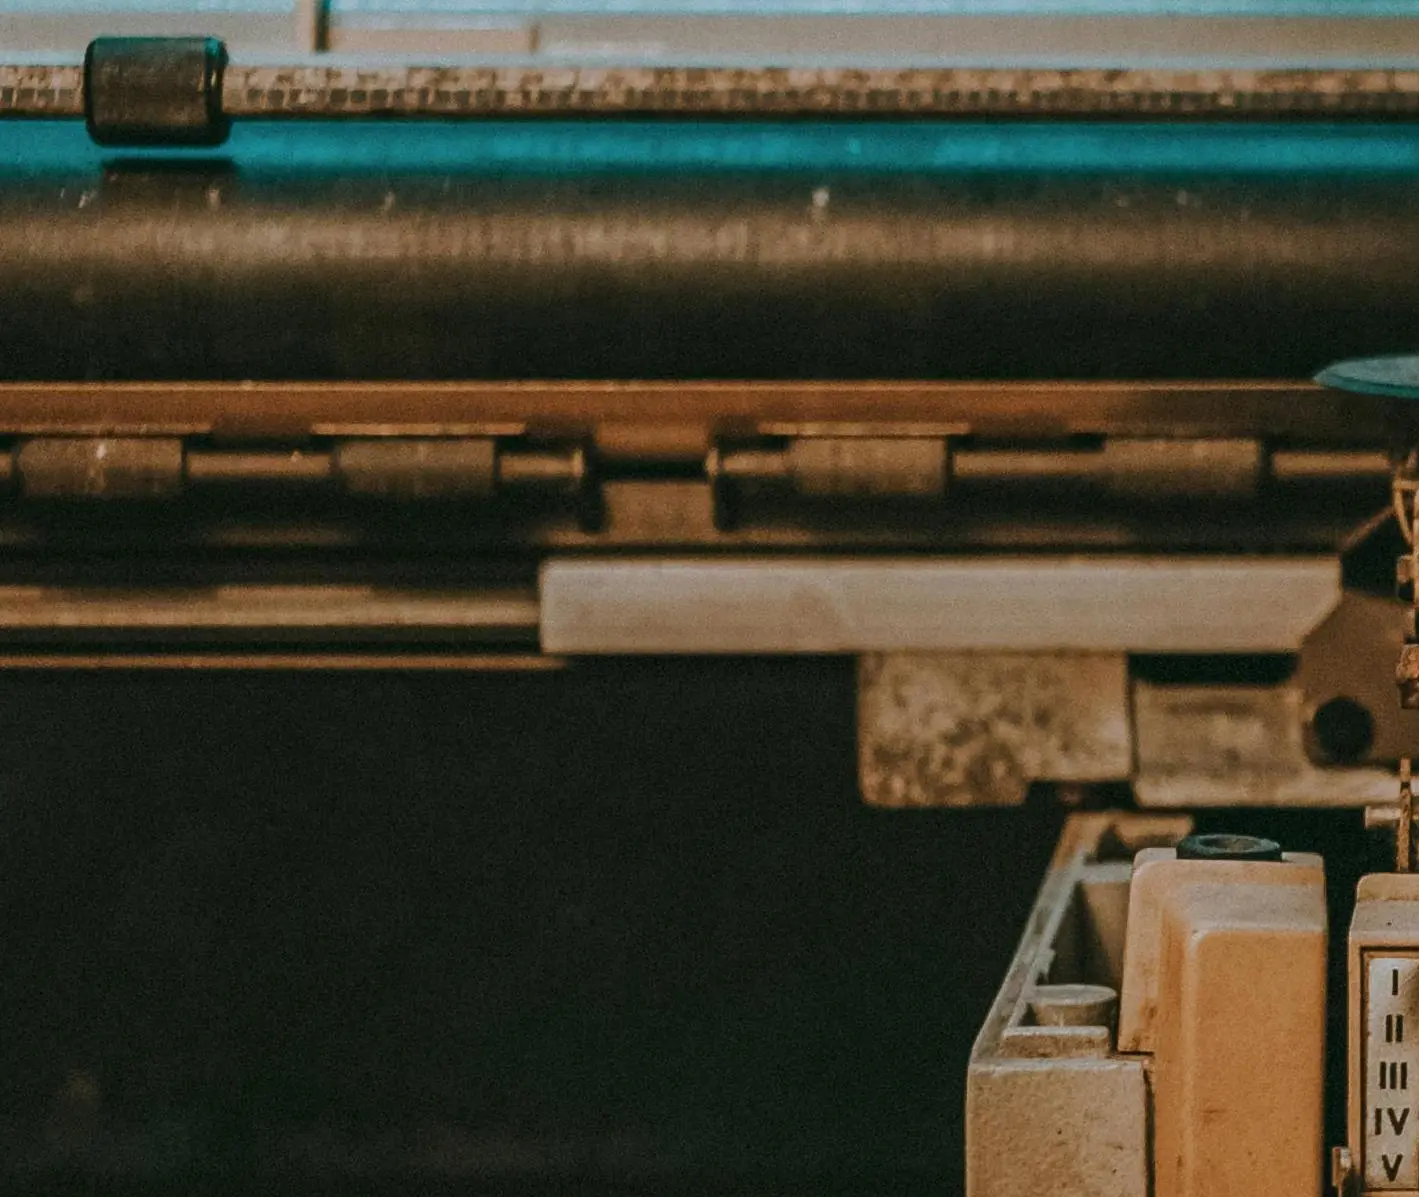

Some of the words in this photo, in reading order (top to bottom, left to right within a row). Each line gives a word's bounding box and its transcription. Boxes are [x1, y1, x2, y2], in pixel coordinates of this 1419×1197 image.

[1391, 968, 1399, 996] I
[1385, 1014, 1404, 1043] II
[1379, 1061, 1408, 1090] III
[1375, 1107, 1410, 1136] IV
[1381, 1154, 1403, 1182] V
